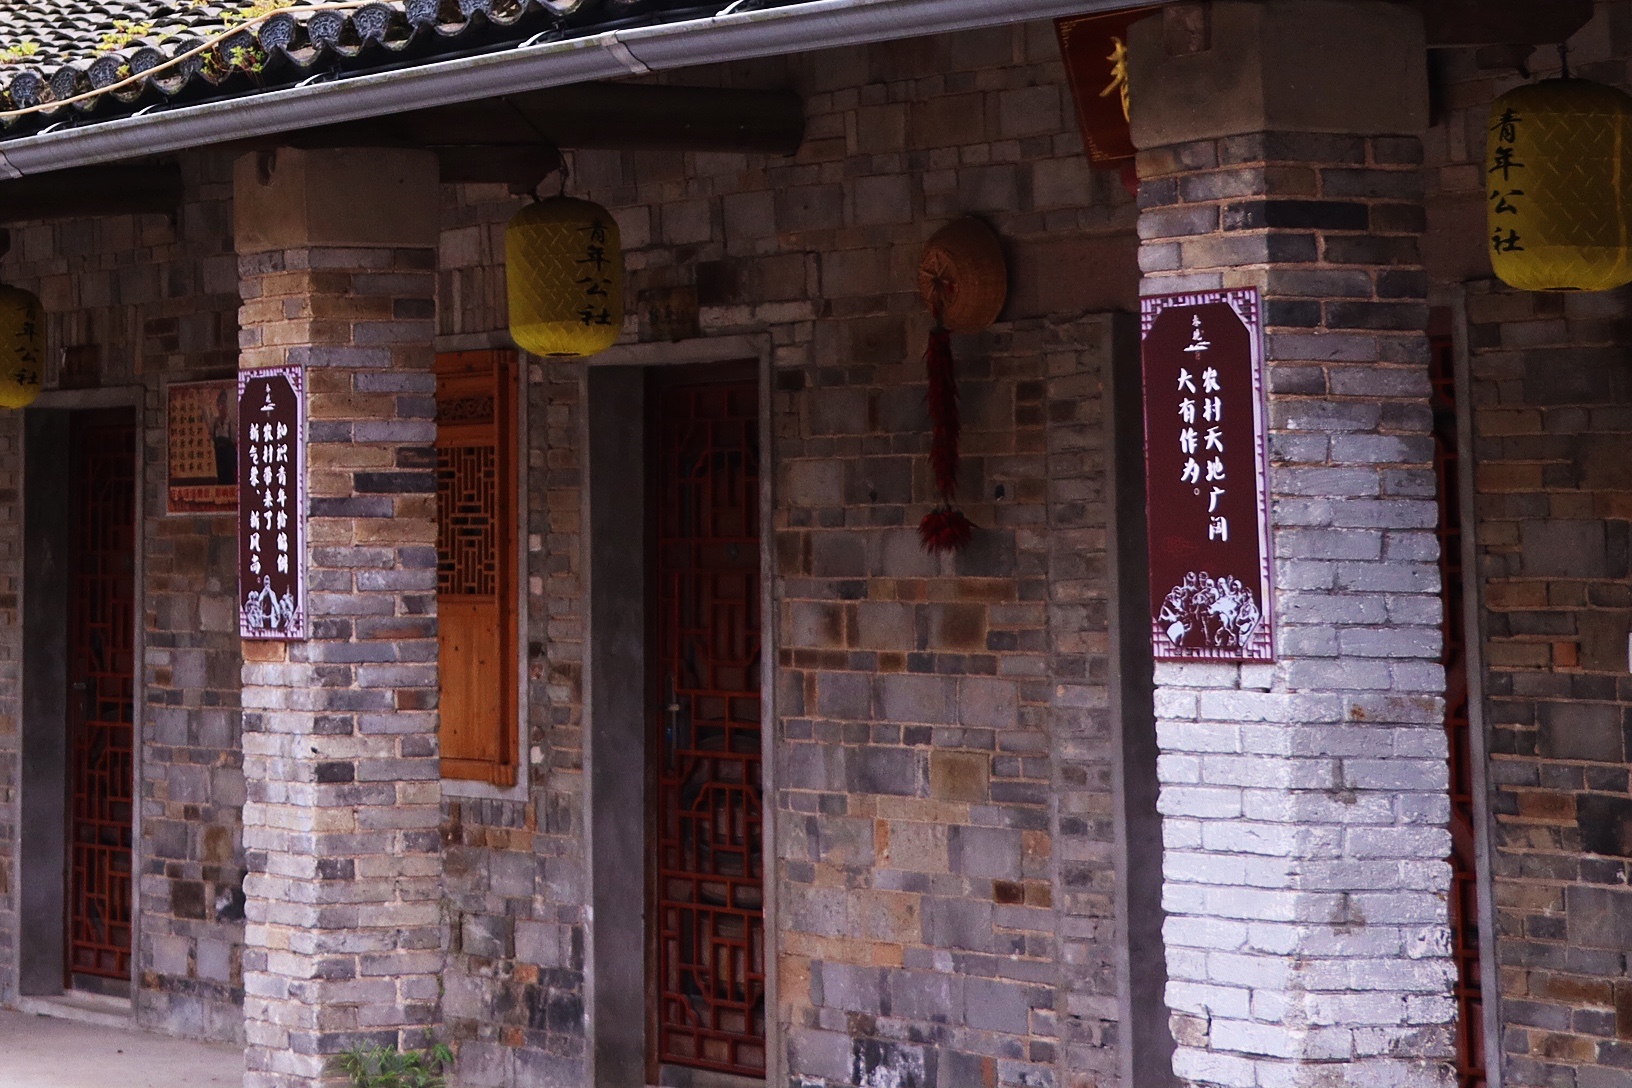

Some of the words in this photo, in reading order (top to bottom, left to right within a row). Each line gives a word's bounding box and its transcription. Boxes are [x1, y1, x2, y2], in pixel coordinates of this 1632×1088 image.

[1488, 108, 1525, 255] 青年公社
[575, 217, 613, 327] 青年公社
[14, 301, 40, 386] 青年公社
[1202, 365, 1228, 543] 农村天地广阔
